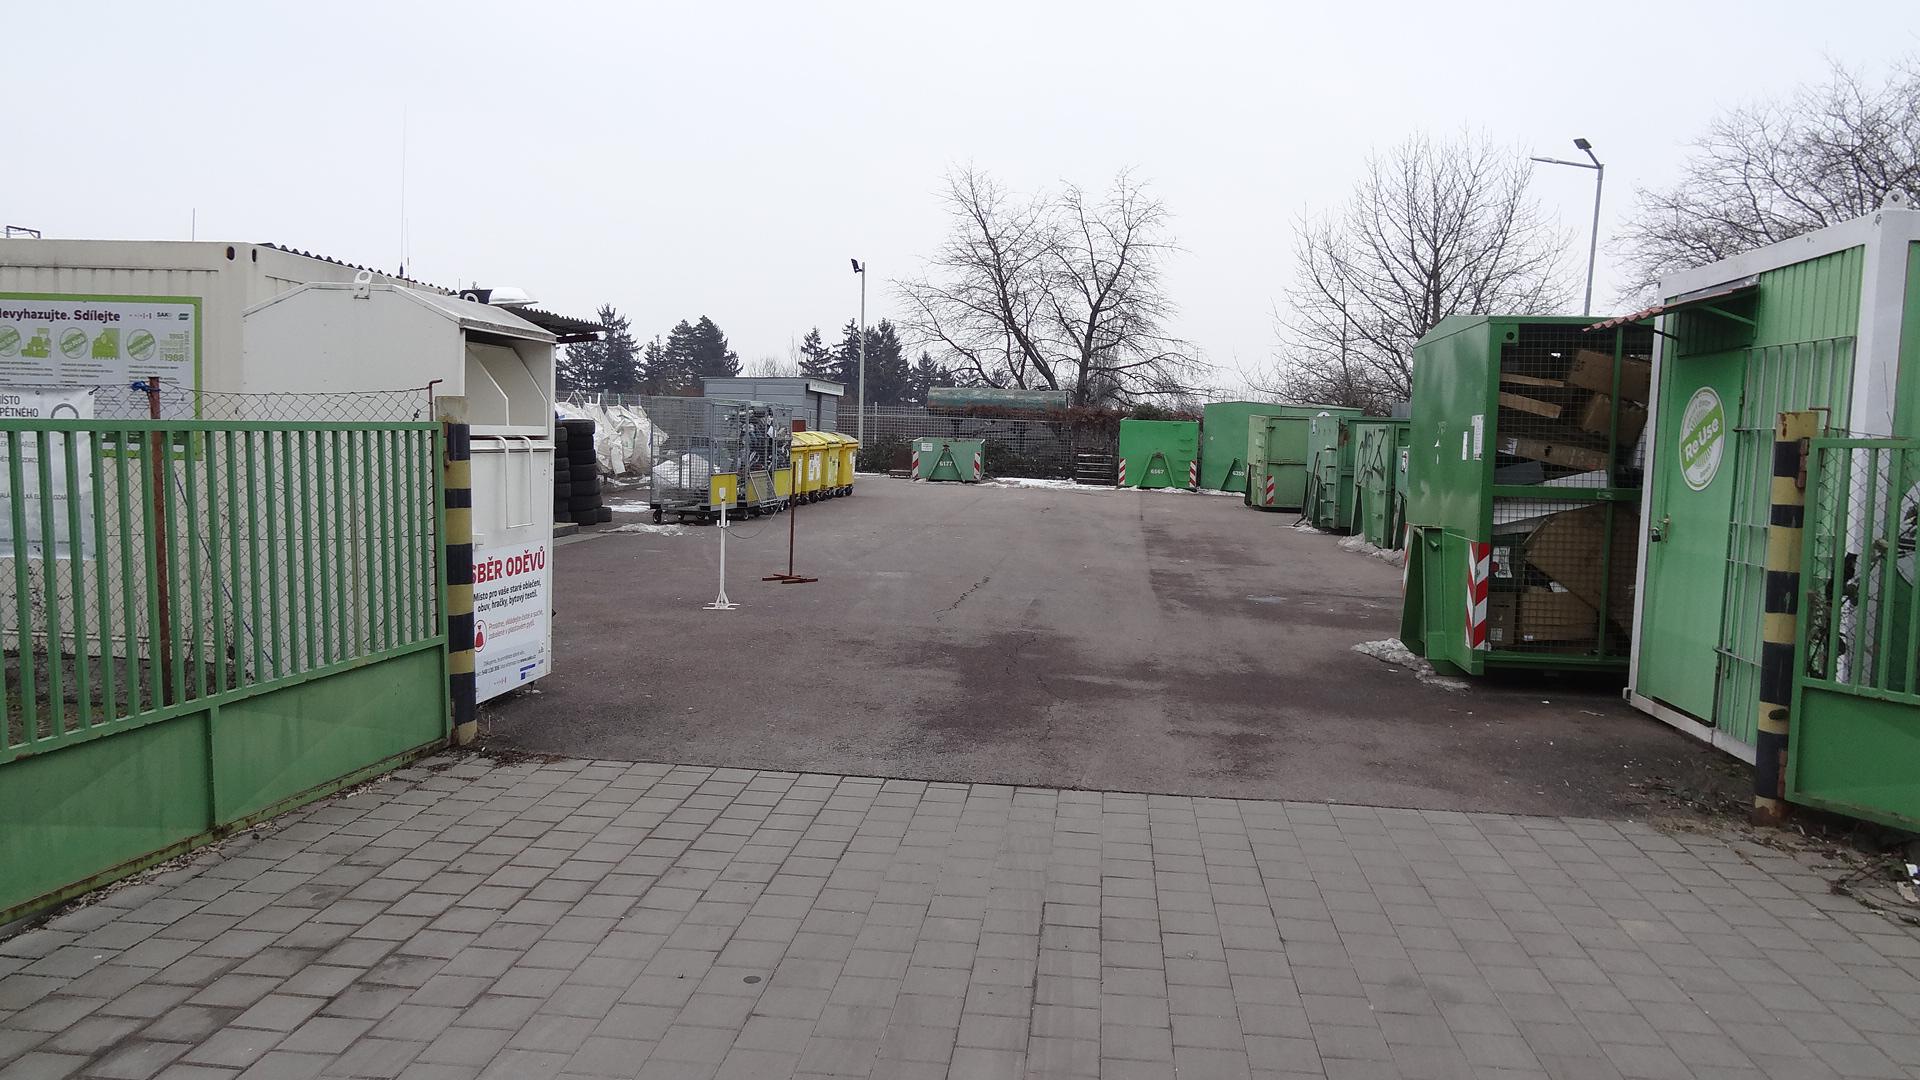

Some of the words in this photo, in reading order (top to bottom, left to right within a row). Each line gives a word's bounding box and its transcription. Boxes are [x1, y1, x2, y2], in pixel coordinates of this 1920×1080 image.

[74, 309, 120, 324] Sdílejte
[0, 394, 20, 405] ÍSTO
[506, 546, 545, 577] ODĚVŮ
[489, 590, 498, 600] pro
[498, 586, 509, 596] vaše
[510, 582, 522, 593] staré
[477, 602, 491, 612] obuv,
[491, 597, 508, 608] hračky,
